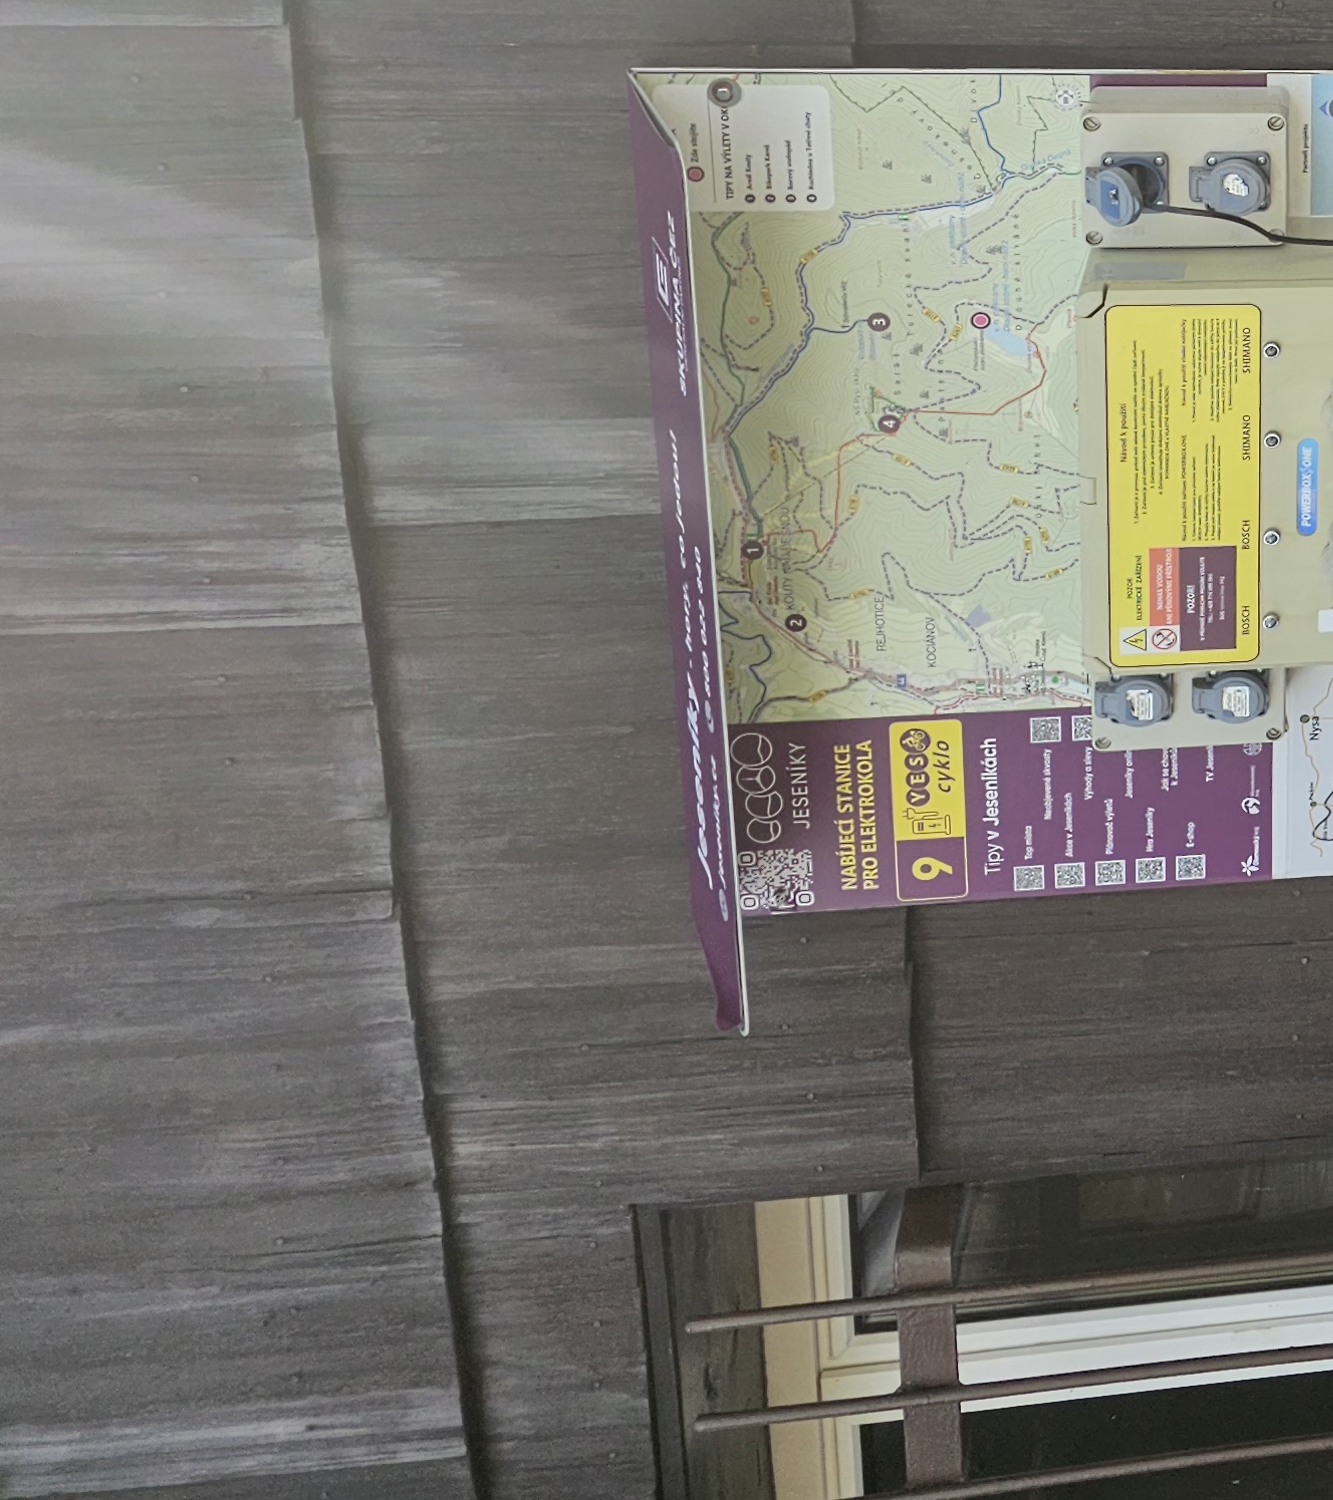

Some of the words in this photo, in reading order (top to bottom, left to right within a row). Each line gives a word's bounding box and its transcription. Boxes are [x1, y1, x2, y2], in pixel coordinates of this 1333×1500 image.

[690, 149, 699, 163] Zde
[720, 131, 732, 163] VÝLETY
[723, 165, 733, 179] NA
[725, 181, 735, 200] TIPY
[665, 210, 679, 270] ČEZ
[671, 276, 688, 397] SKUPINA
[1241, 327, 1252, 375] SHIMANO
[1118, 403, 1129, 430] použití
[1118, 438, 1128, 463] Návod
[1240, 414, 1251, 462] SHIMANO
[1301, 446, 1313, 468] ONE
[1300, 473, 1313, 528] POWERBOX
[1240, 519, 1251, 551] BOSCH
[1134, 555, 1142, 584] ZAŘÍZENÍ
[782, 577, 796, 611] KOUTY
[1135, 586, 1143, 621] ELEKTRICKÉ
[1186, 584, 1196, 614] POZOR!
[874, 596, 887, 652] REJHOTICE
[1240, 604, 1251, 636] BOSCH
[924, 617, 936, 668] KOCIÁNOV
[1309, 715, 1322, 741] Nysa
[931, 740, 953, 794] cyklo
[1043, 748, 1053, 776] skvosty
[1083, 746, 1093, 765] slevy
[1124, 749, 1133, 767] onlin
[787, 741, 811, 830] JESENÍKY
[833, 743, 852, 813] STANICE
[905, 754, 930, 805] YES
[979, 737, 1000, 827] Jeseníkách
[1084, 772, 1094, 800] Výhody
[1124, 767, 1135, 799] Jeseníky
[1161, 768, 1169, 777] se
[1205, 771, 1214, 783] TV
[854, 739, 878, 853] ELEKTROKOLA
[1063, 792, 1073, 832] Jeseníkách
[987, 831, 1000, 840] v
[1023, 825, 1033, 846] místa
[1104, 821, 1114, 855] Plánovač
[1145, 806, 1155, 838] Jeseníky
[1185, 821, 1196, 848] E-shop
[833, 818, 858, 891] NABÍJECÍ
[983, 843, 1004, 876] Tipy
[1024, 847, 1034, 860] Top
[1064, 839, 1074, 857] Akce
[861, 856, 880, 890] PRO
[911, 855, 953, 882] 9
